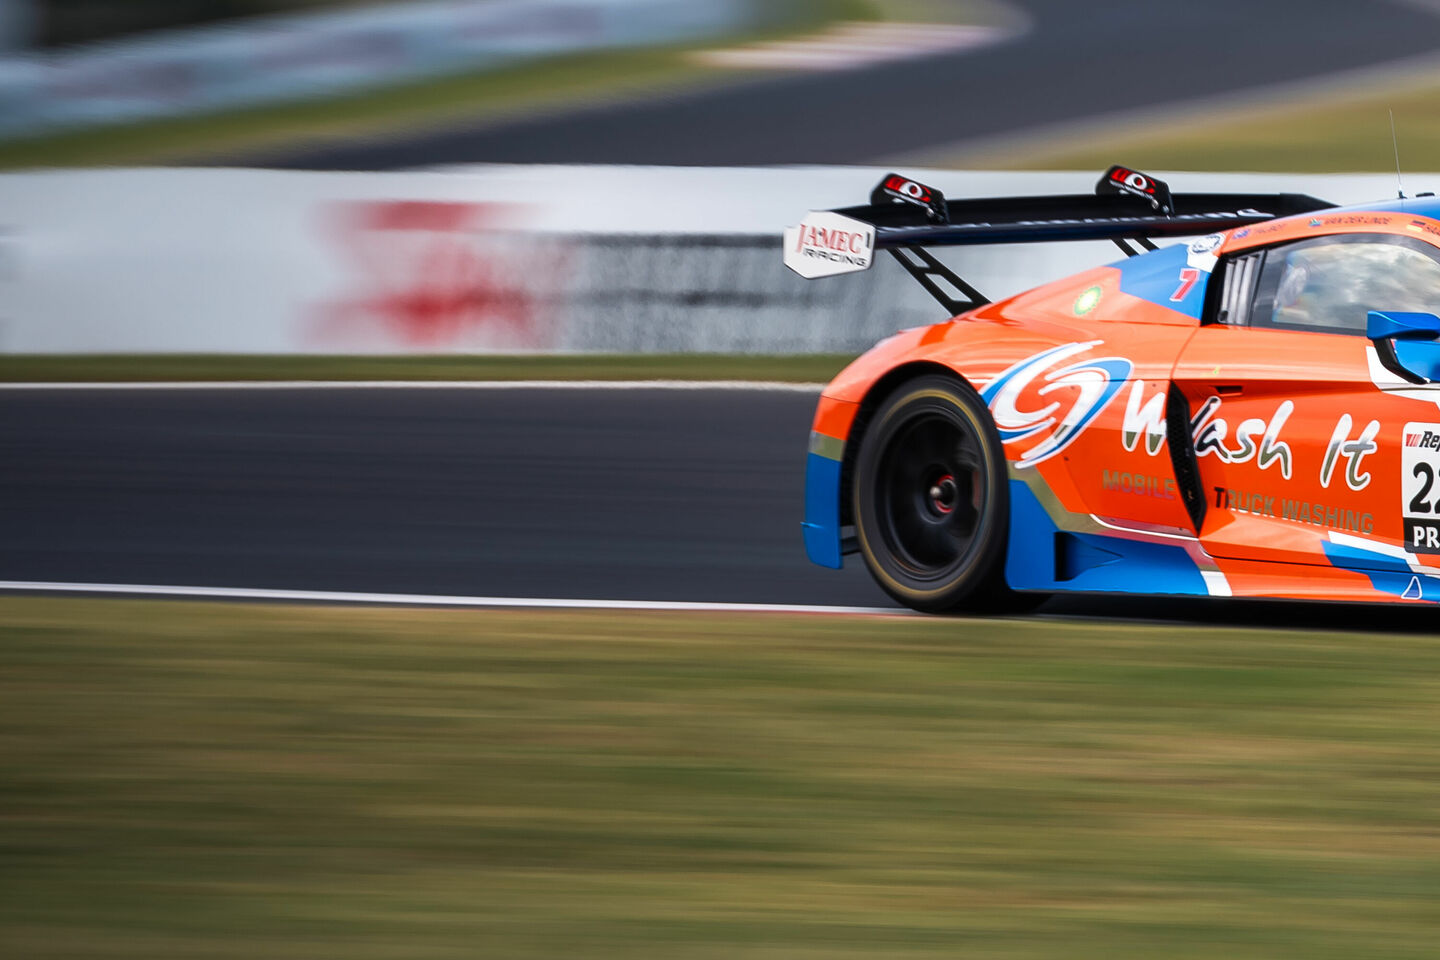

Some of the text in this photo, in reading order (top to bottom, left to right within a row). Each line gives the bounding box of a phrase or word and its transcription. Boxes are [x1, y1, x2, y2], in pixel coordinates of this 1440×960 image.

[796, 223, 864, 254] JAMEC
[802, 247, 868, 268] RACING
[1121, 379, 1381, 491] Wash It
[1102, 469, 1375, 535] MOBILE TRUCK WASHING
